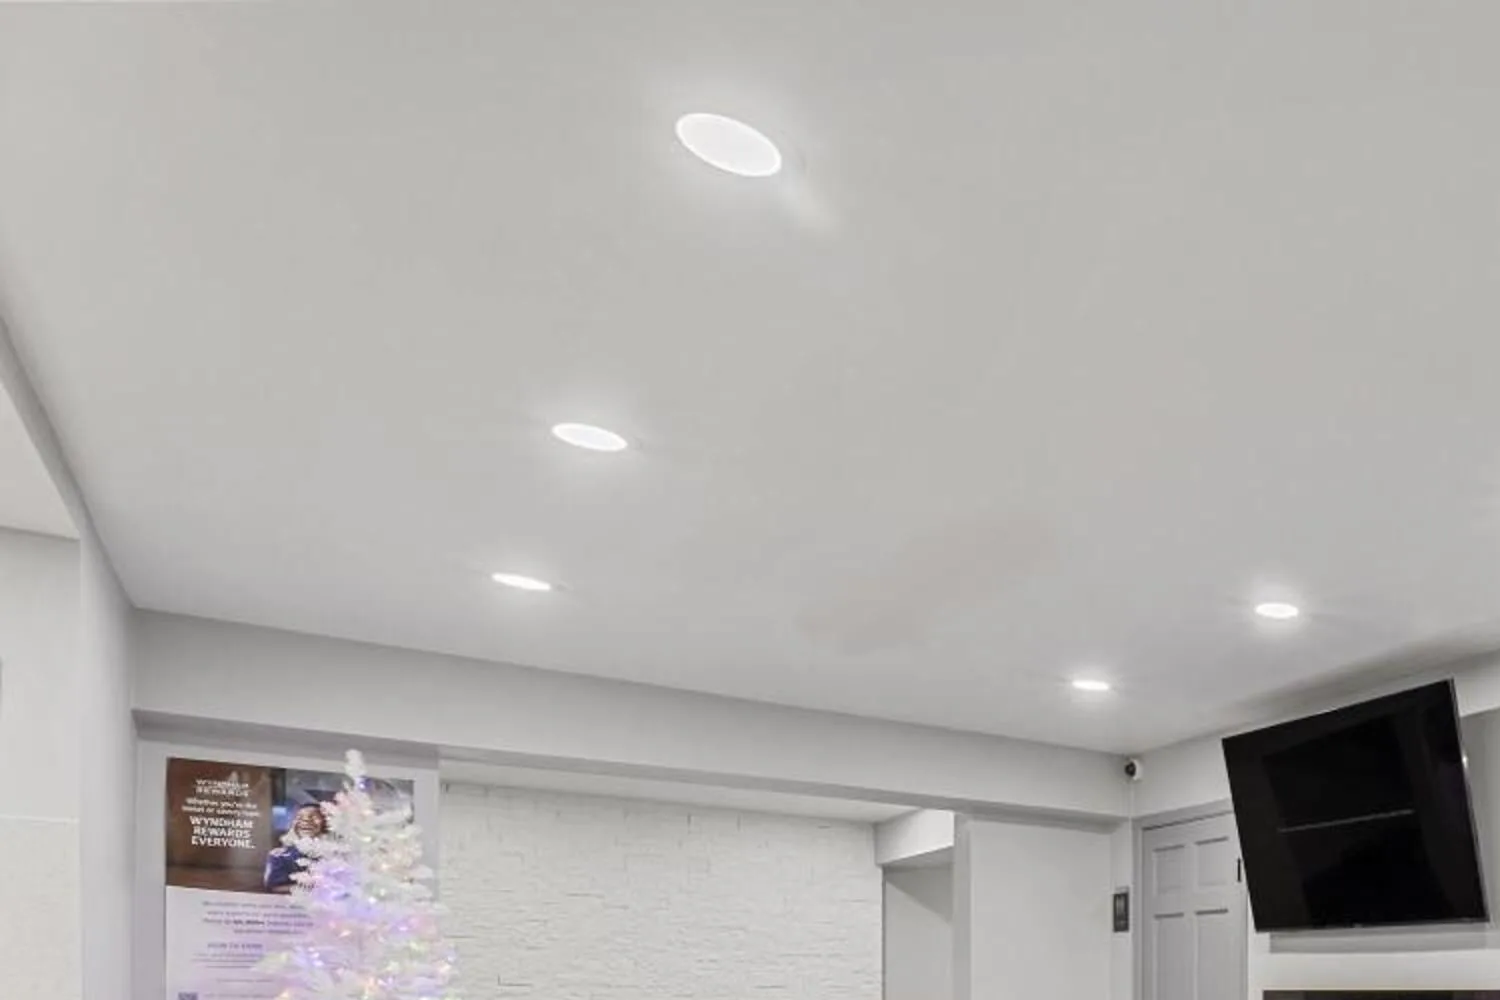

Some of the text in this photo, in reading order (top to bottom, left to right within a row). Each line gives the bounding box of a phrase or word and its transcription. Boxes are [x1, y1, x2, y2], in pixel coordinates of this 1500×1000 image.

[189, 815, 253, 829] WYNDHAM
[193, 826, 251, 839] REWARDS
[191, 835, 256, 849] EVERYONE.
